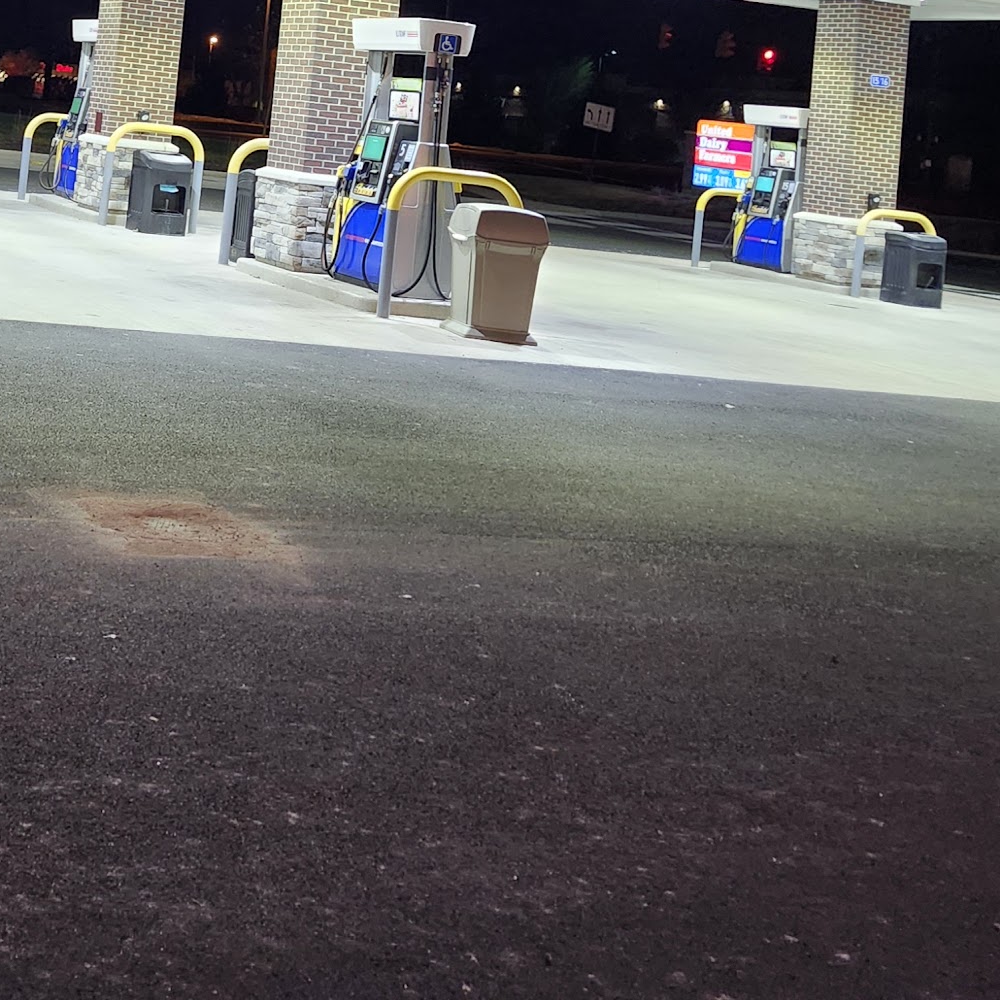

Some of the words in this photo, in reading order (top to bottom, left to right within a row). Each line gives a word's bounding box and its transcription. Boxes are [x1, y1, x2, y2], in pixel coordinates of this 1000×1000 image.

[700, 124, 733, 138] United
[399, 143, 407, 156] 5
[699, 136, 728, 152] Dairy
[698, 149, 737, 165] Farmers
